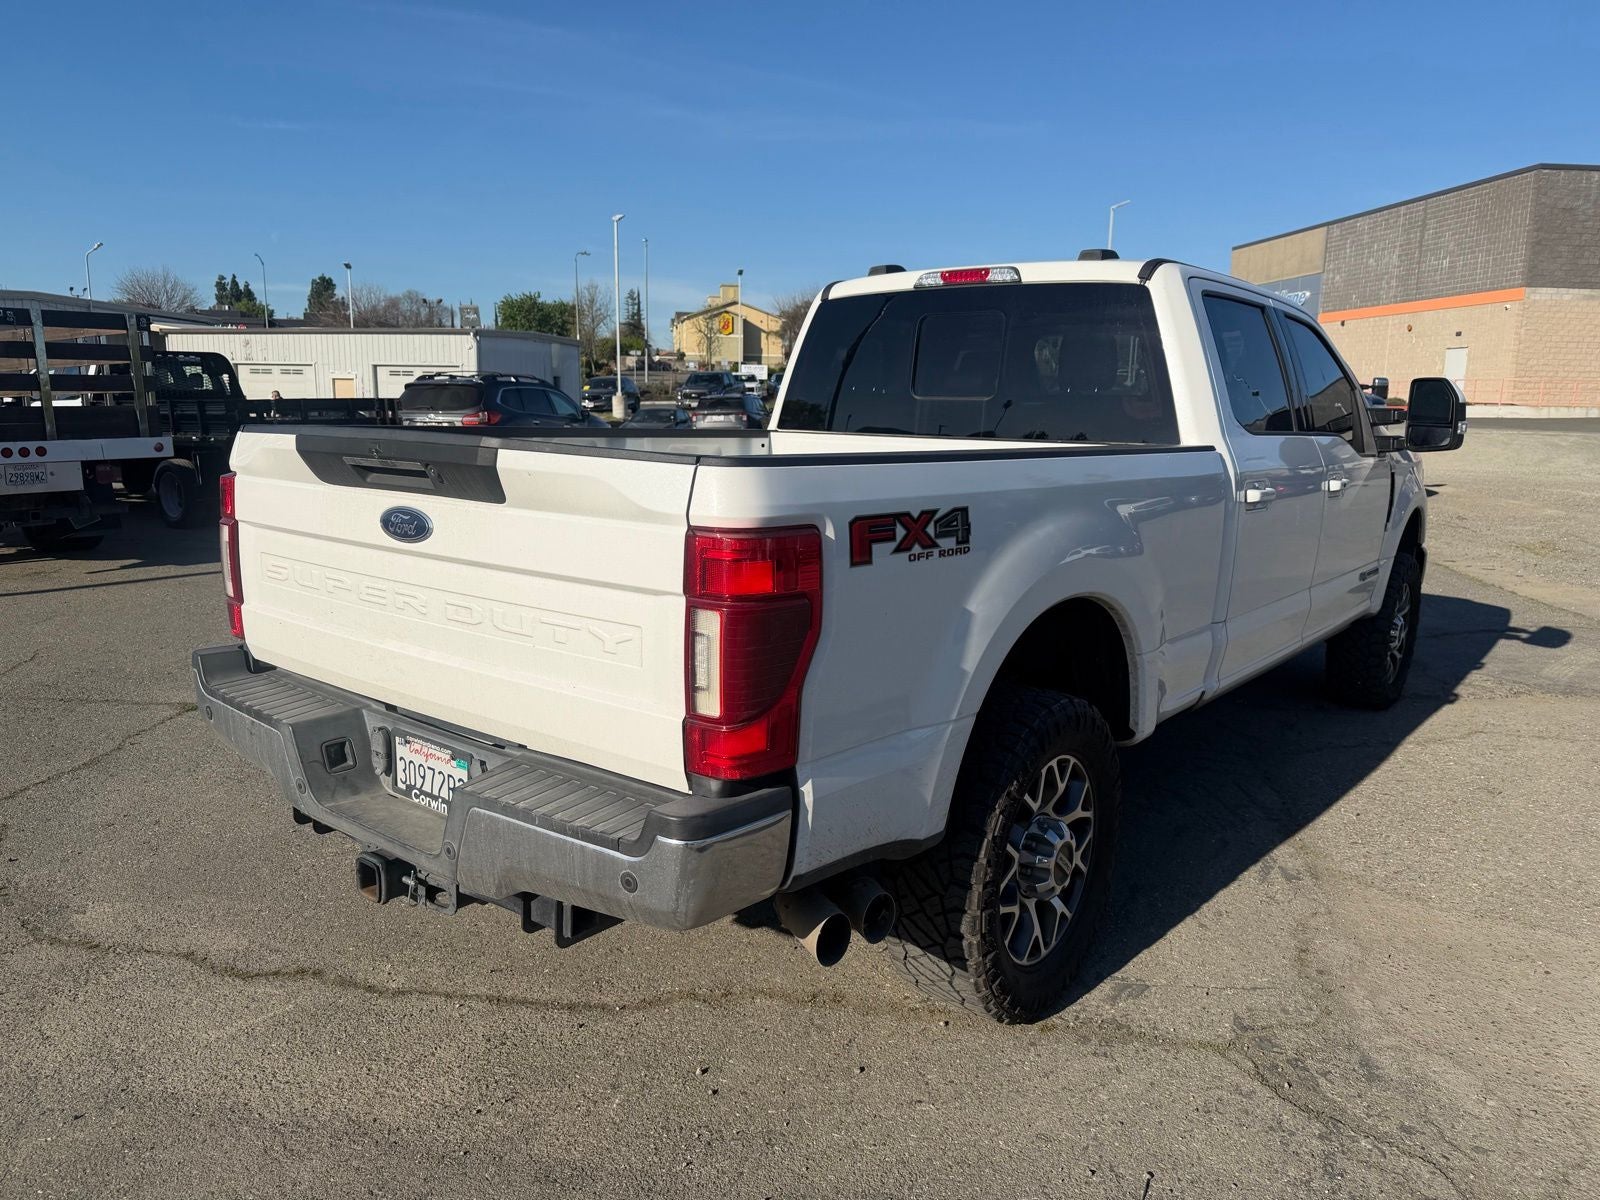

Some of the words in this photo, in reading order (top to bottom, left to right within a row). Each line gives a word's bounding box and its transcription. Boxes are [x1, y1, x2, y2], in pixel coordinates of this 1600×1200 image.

[388, 512, 418, 536] Ford
[848, 506, 971, 568] FX4
[908, 550, 934, 563] OFF
[938, 546, 971, 559] ROAD
[265, 561, 428, 616] SUPER
[444, 599, 633, 655] DUTY
[408, 741, 456, 768] California
[399, 756, 465, 801] 30972R
[411, 789, 448, 815] Corwin
